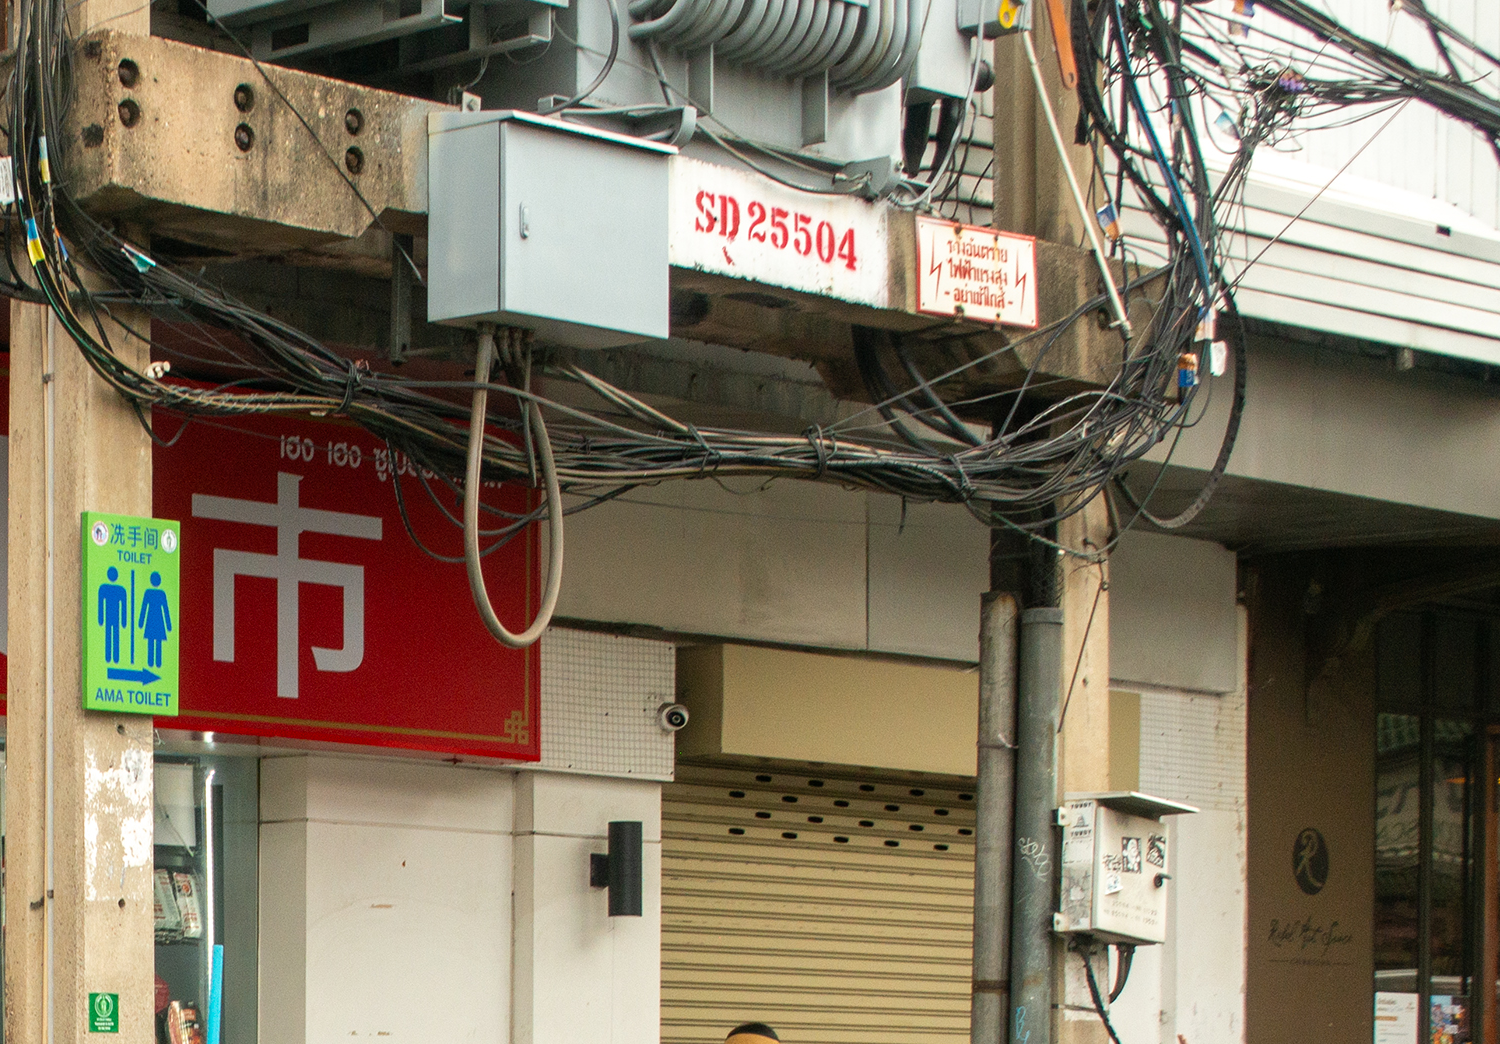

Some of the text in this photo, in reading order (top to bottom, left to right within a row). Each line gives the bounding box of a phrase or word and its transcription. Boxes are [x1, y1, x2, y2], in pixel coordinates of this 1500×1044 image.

[110, 523, 159, 550] 洗手间
[117, 549, 152, 565] TOILET
[95, 687, 171, 707] AMA TOILET
